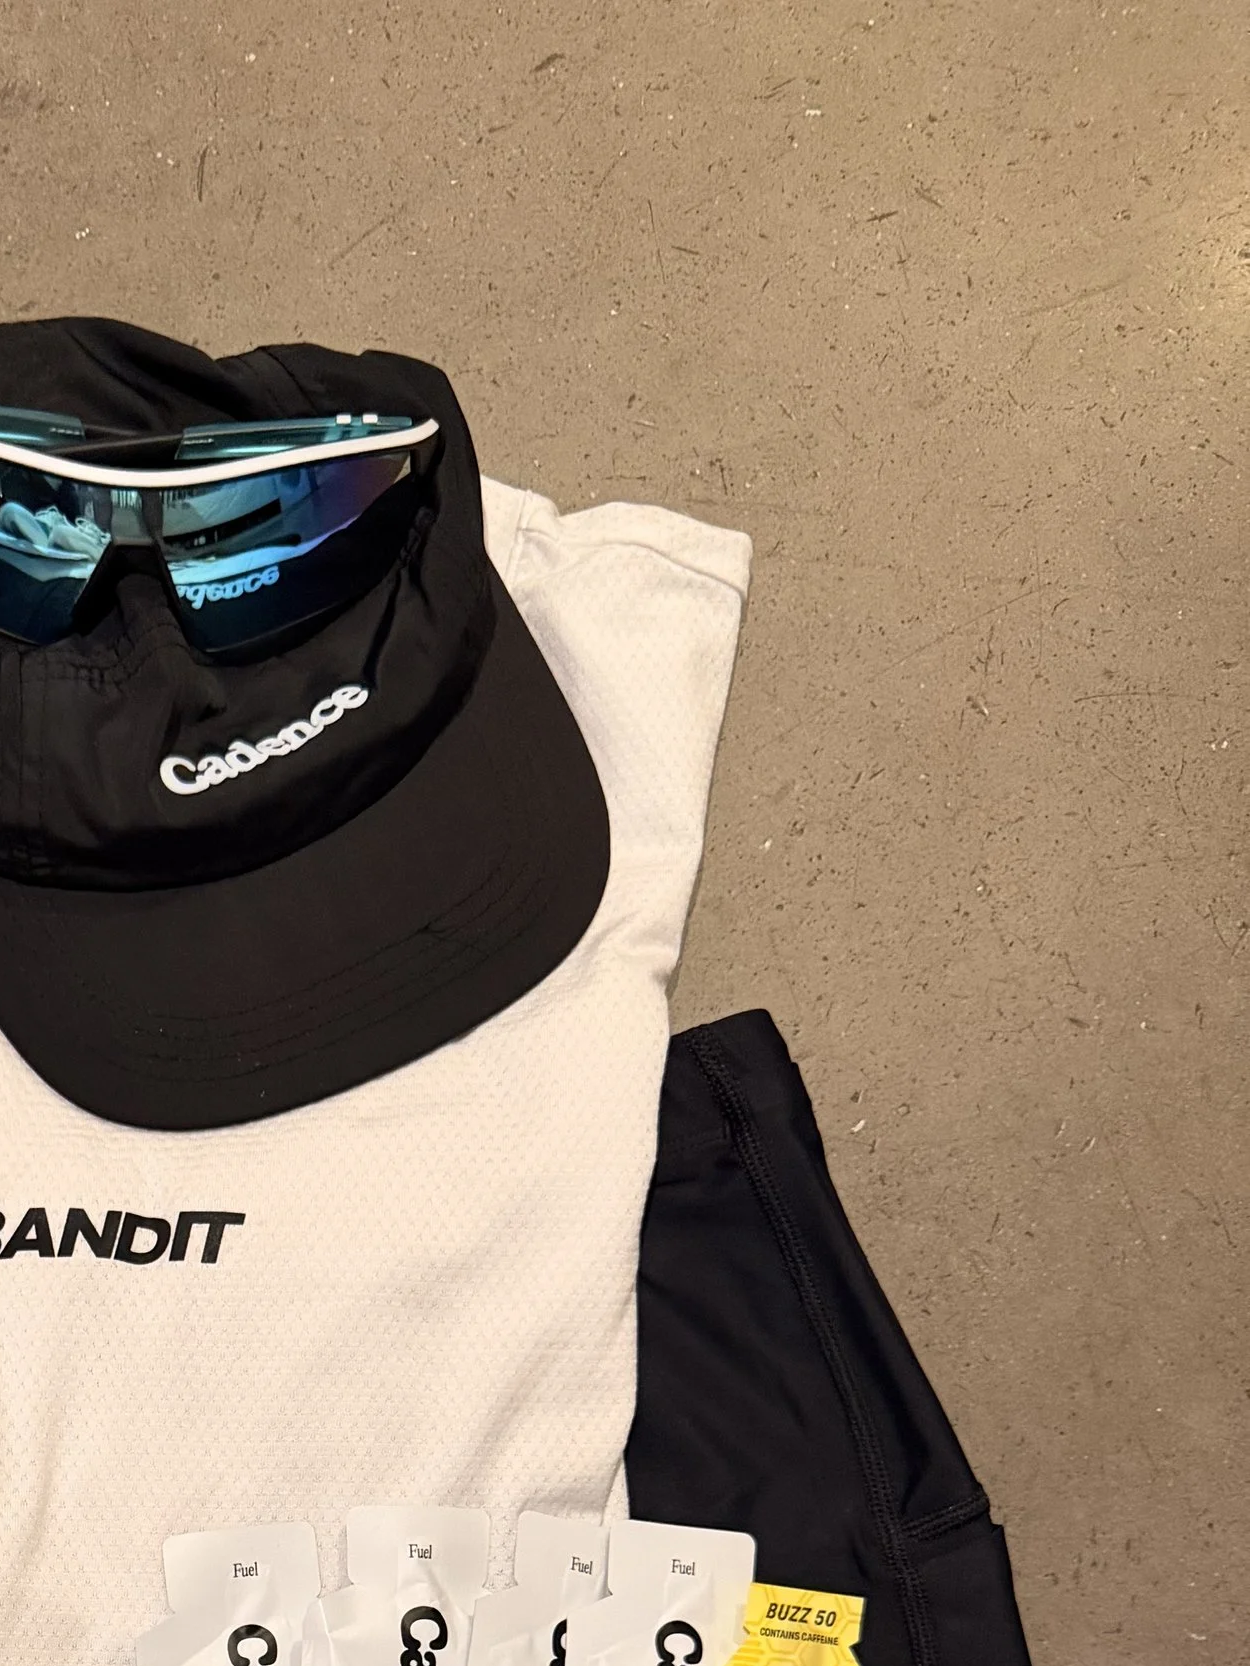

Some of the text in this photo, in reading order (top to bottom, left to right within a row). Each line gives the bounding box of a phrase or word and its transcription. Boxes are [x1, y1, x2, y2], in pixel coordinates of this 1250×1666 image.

[159, 685, 369, 795] Cadence
[409, 1544, 432, 1559] Fuel
[233, 1562, 259, 1578] Fuel
[571, 1556, 593, 1575] Fuel
[671, 1559, 696, 1576] Fuel
[766, 1603, 837, 1627] BUZZ 50
[759, 1627, 839, 1646] CONTAINS CAFFEINE
